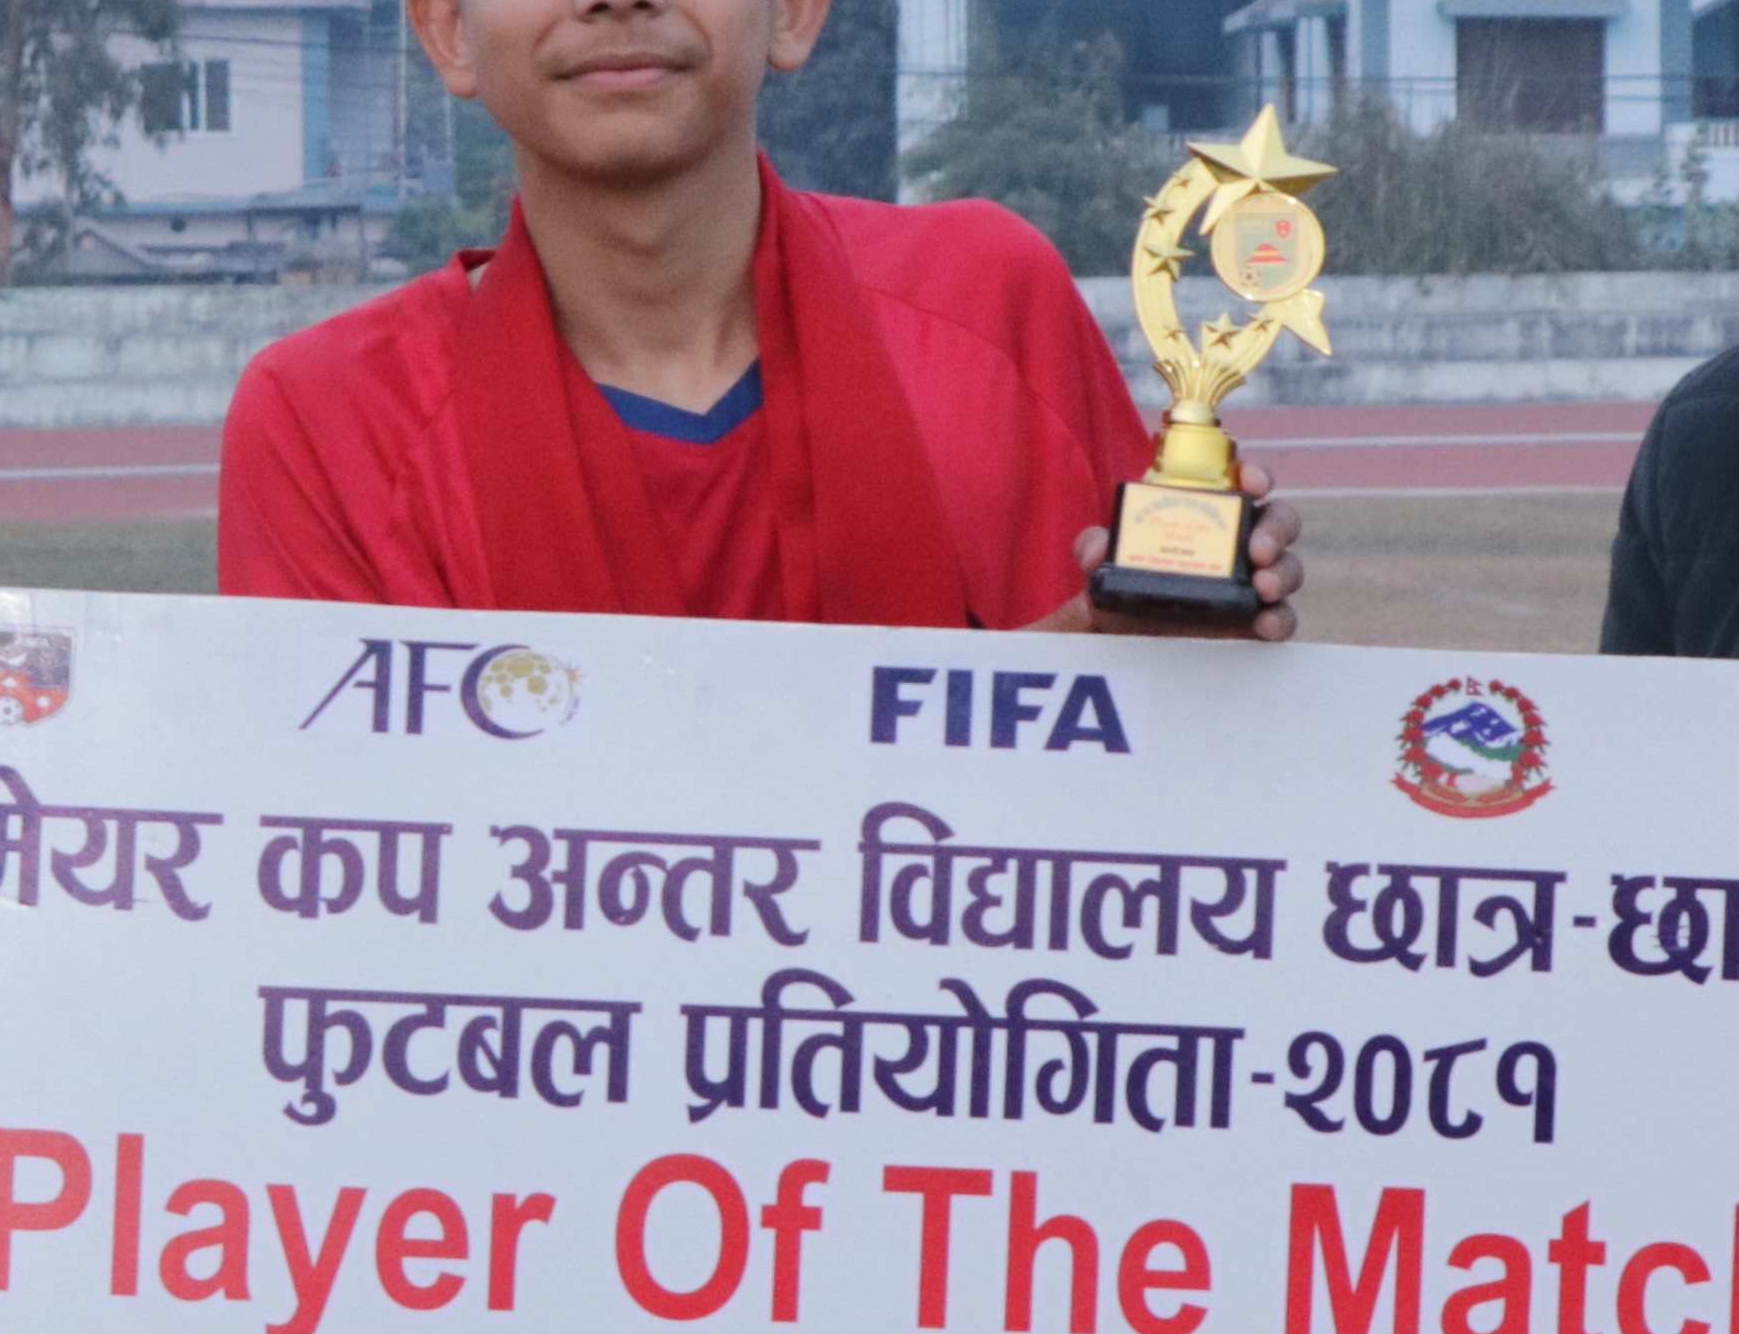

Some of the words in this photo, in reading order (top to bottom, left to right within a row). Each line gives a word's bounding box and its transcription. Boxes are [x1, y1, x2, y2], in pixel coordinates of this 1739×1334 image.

[301, 638, 546, 740] AFC
[870, 666, 1131, 754] FIFA
[258, 815, 452, 924] कप
[488, 825, 821, 947] अन्तर
[858, 801, 1288, 961] विद्यालय
[258, 986, 643, 1126] फुटबल
[679, 963, 1558, 1145] प्रतियोगिता-२०८१
[615, 1153, 831, 1323] Of
